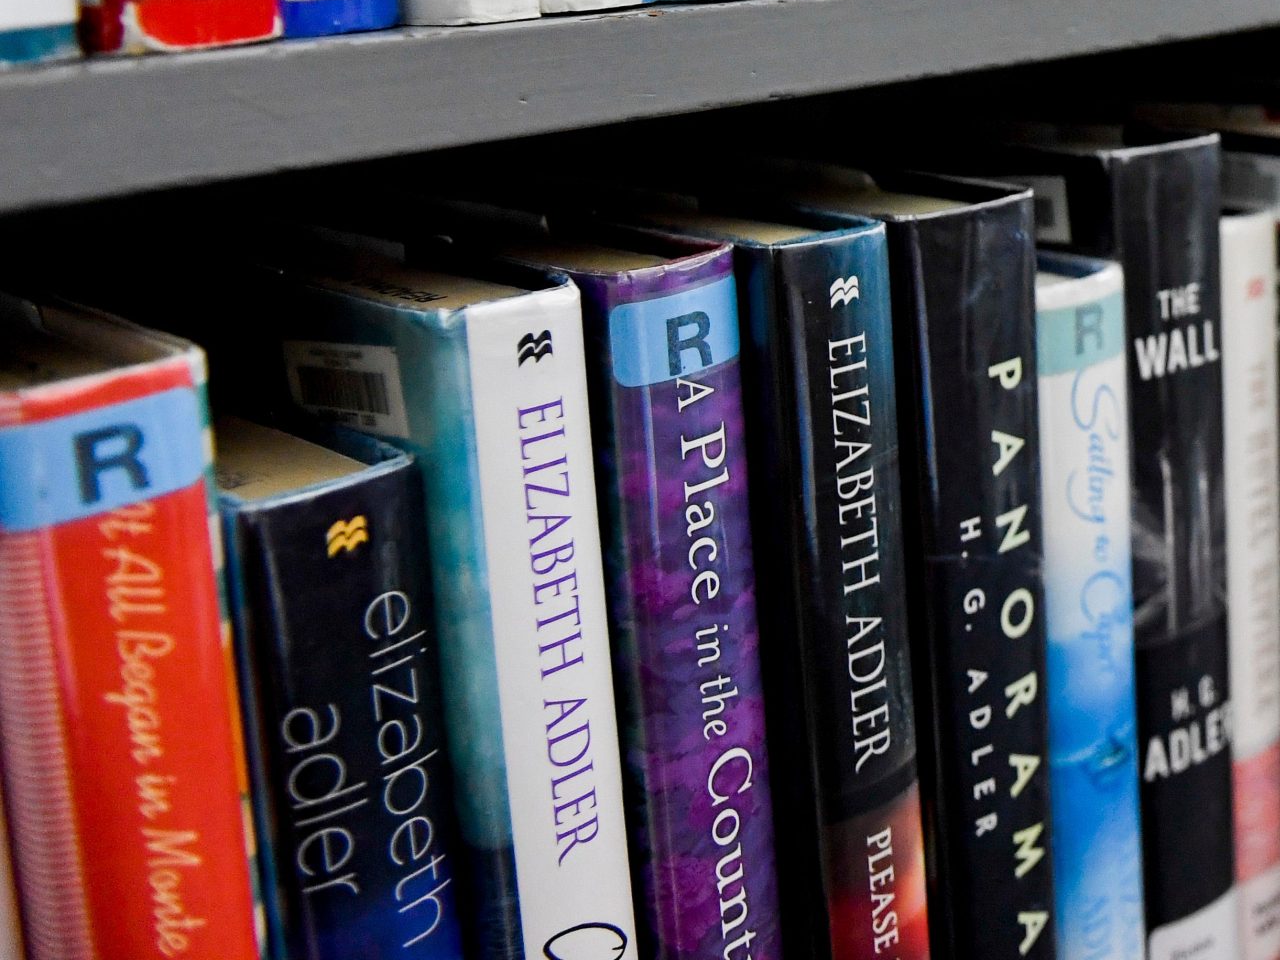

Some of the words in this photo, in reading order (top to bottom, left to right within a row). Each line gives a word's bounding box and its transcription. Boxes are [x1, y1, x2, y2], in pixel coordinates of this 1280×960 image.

[666, 311, 714, 377] R
[1135, 321, 1220, 382] WALL
[1157, 282, 1200, 321] THE
[676, 377, 715, 412] A
[1066, 369, 1121, 525] Sailing
[73, 422, 151, 505] R
[681, 421, 729, 604] Place
[828, 331, 881, 596] ELIZABETH
[103, 547, 166, 621] All
[517, 395, 584, 681] ELIZABETH
[960, 516, 983, 567] H.
[695, 624, 729, 667] in
[964, 588, 986, 632] G.
[988, 356, 1049, 956] PANORAMA
[103, 630, 176, 763] Began
[700, 675, 739, 740] the
[846, 615, 891, 774] ADLER
[967, 668, 998, 838] ADLER
[135, 774, 176, 820] in
[282, 704, 368, 895] adler
[365, 591, 452, 948] elizabeth
[543, 697, 600, 867] ADLER
[141, 826, 206, 957] Monte
[867, 827, 900, 954] PLEASE
